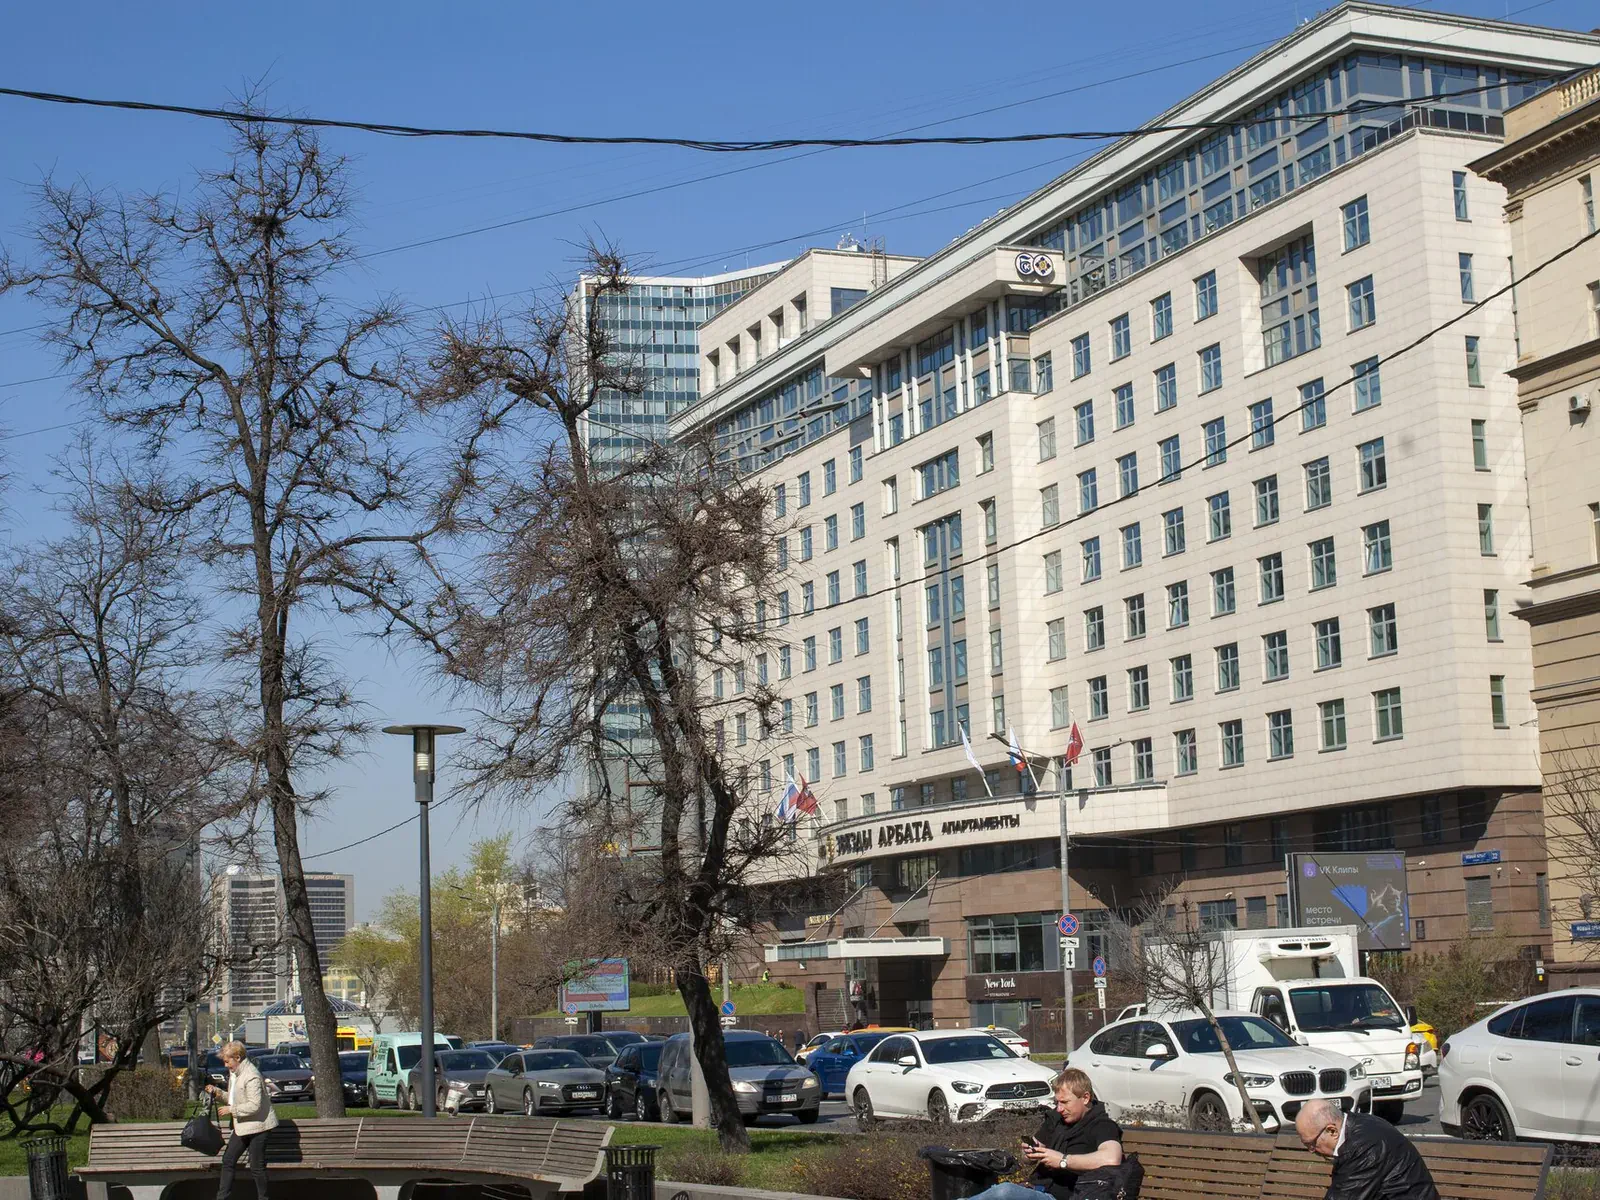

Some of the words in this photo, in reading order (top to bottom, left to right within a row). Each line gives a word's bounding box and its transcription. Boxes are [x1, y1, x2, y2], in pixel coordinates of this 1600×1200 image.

[878, 820, 934, 848] АРБАТА
[941, 814, 1020, 835] АПАРТАМЕНТЫ
[1320, 866, 1331, 874] VK
[1332, 866, 1359, 874] Клипы
[1306, 917, 1342, 925] встречи
[984, 978, 1000, 989] New
[1000, 977, 1016, 988] York
